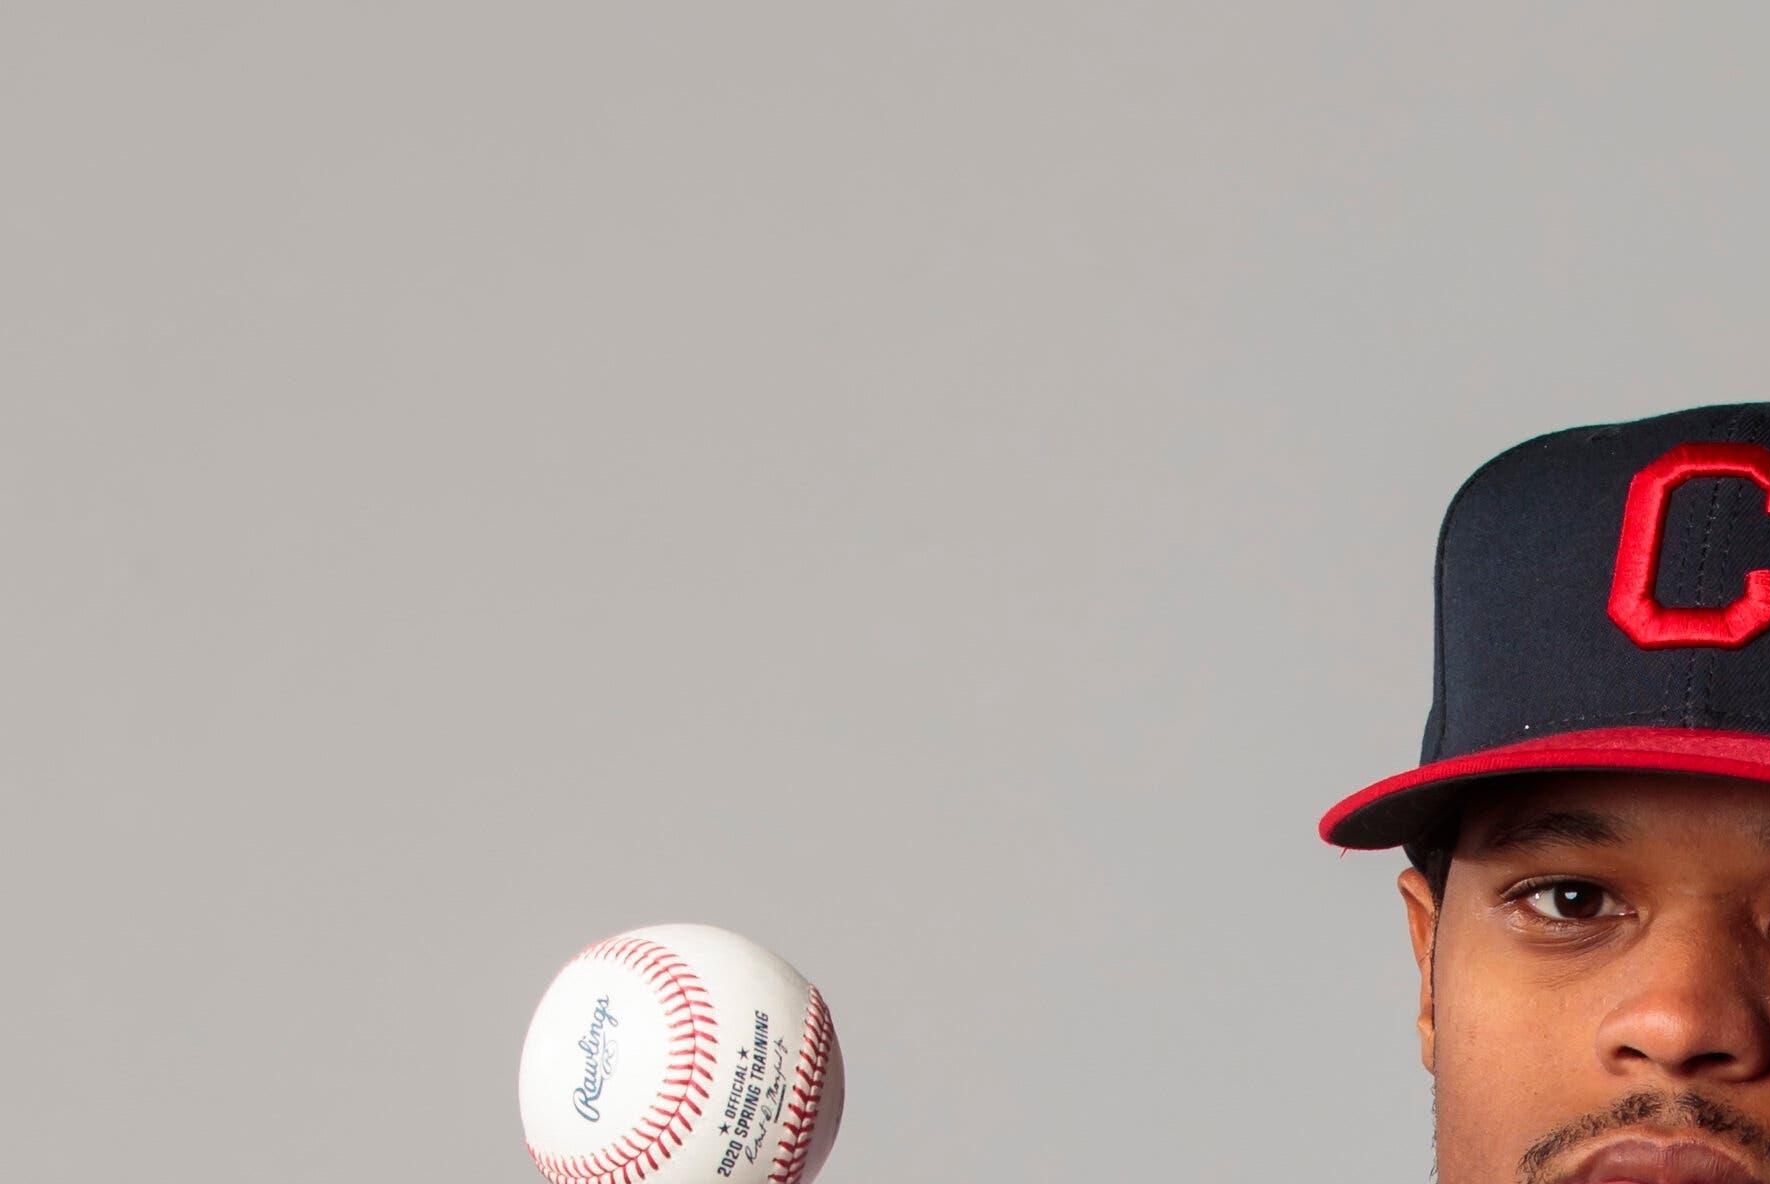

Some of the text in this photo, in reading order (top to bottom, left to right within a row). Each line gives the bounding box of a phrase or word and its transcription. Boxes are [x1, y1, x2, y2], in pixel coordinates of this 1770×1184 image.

[573, 994, 619, 1122] Rawlings
[717, 1010, 769, 1178] 2020 SPRING TRAINING
[724, 1065, 748, 1119] OFFICIAL
